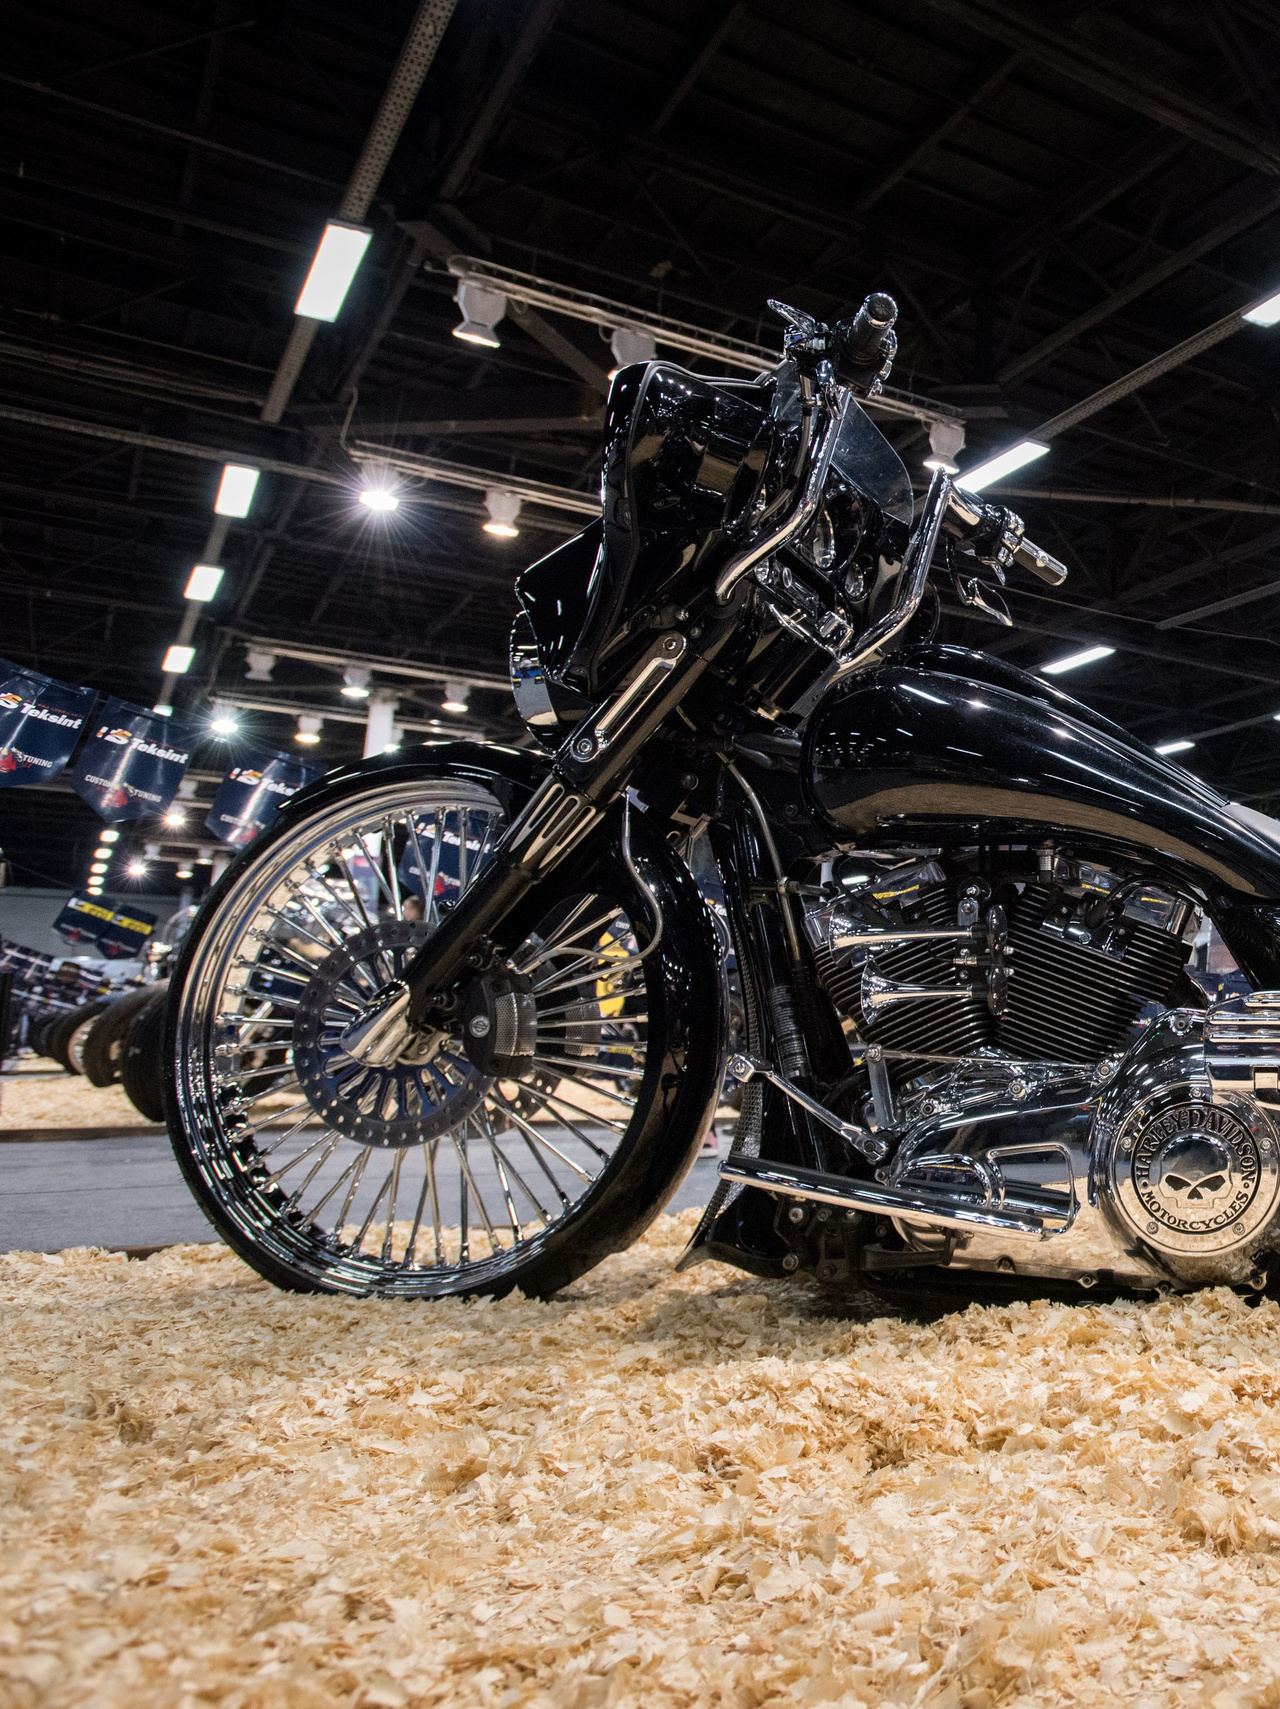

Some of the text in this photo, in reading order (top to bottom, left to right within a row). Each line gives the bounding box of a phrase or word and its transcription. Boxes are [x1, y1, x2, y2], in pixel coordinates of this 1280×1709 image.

[20, 702, 83, 729] Teksint
[131, 737, 190, 764] Teksint
[1136, 1107, 1256, 1183] HARLEY-DAVIDSON
[1141, 1190, 1250, 1231] MOTORCYCLES
